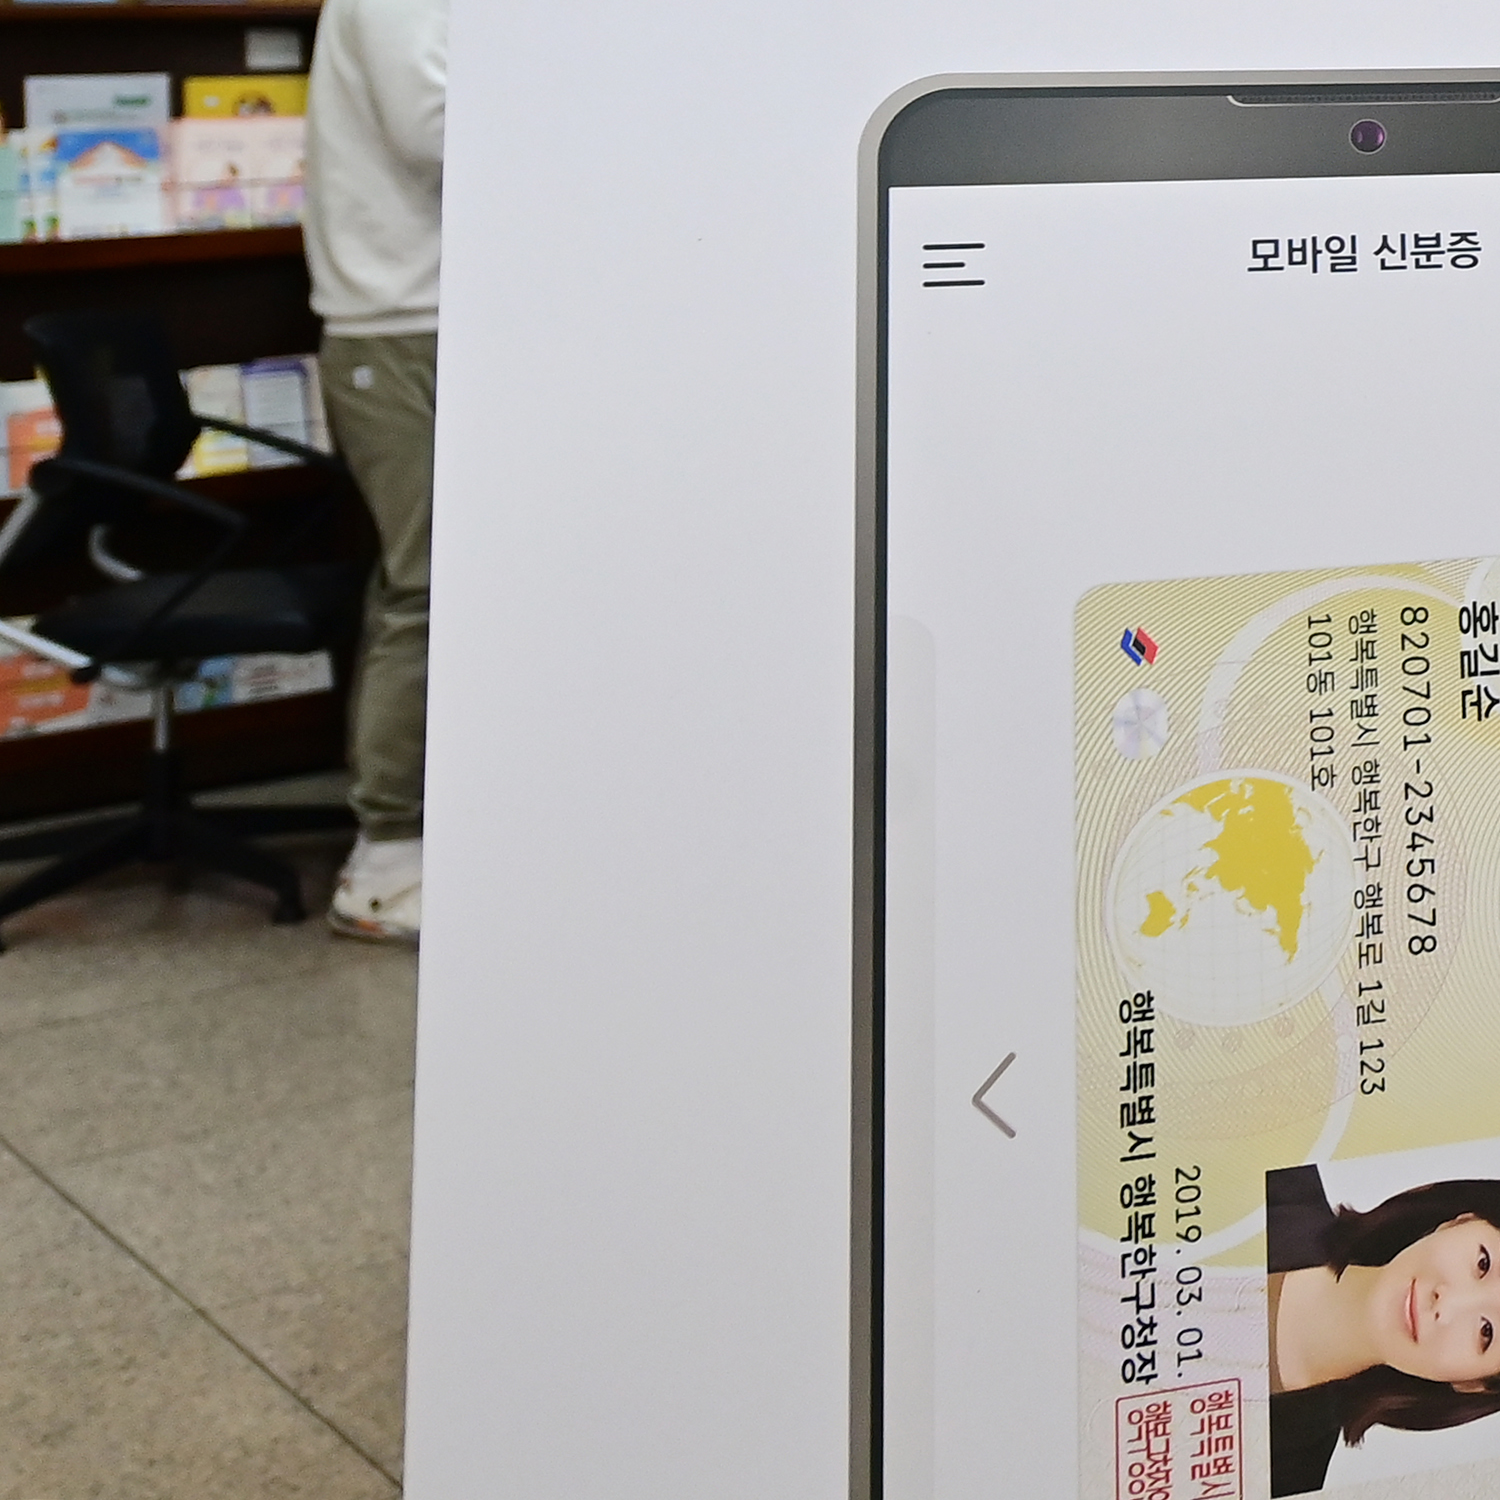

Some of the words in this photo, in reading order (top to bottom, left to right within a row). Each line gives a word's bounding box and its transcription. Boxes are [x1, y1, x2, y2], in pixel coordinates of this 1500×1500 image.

[1247, 233, 1361, 276] 모바일
[1372, 230, 1483, 273] 신분증
[1305, 613, 1336, 696] 101동
[1349, 608, 1381, 748] 행복특별시
[1308, 707, 1339, 793] 101호
[1399, 605, 1438, 958] 820701-2345678
[1350, 758, 1383, 873] 행복한구
[1353, 882, 1385, 970] 행복로
[1356, 980, 1387, 1027] 1길
[1119, 990, 1156, 1163] 행복특별시
[1359, 1039, 1387, 1097] 123
[1119, 1173, 1158, 1386] 행복한구청장
